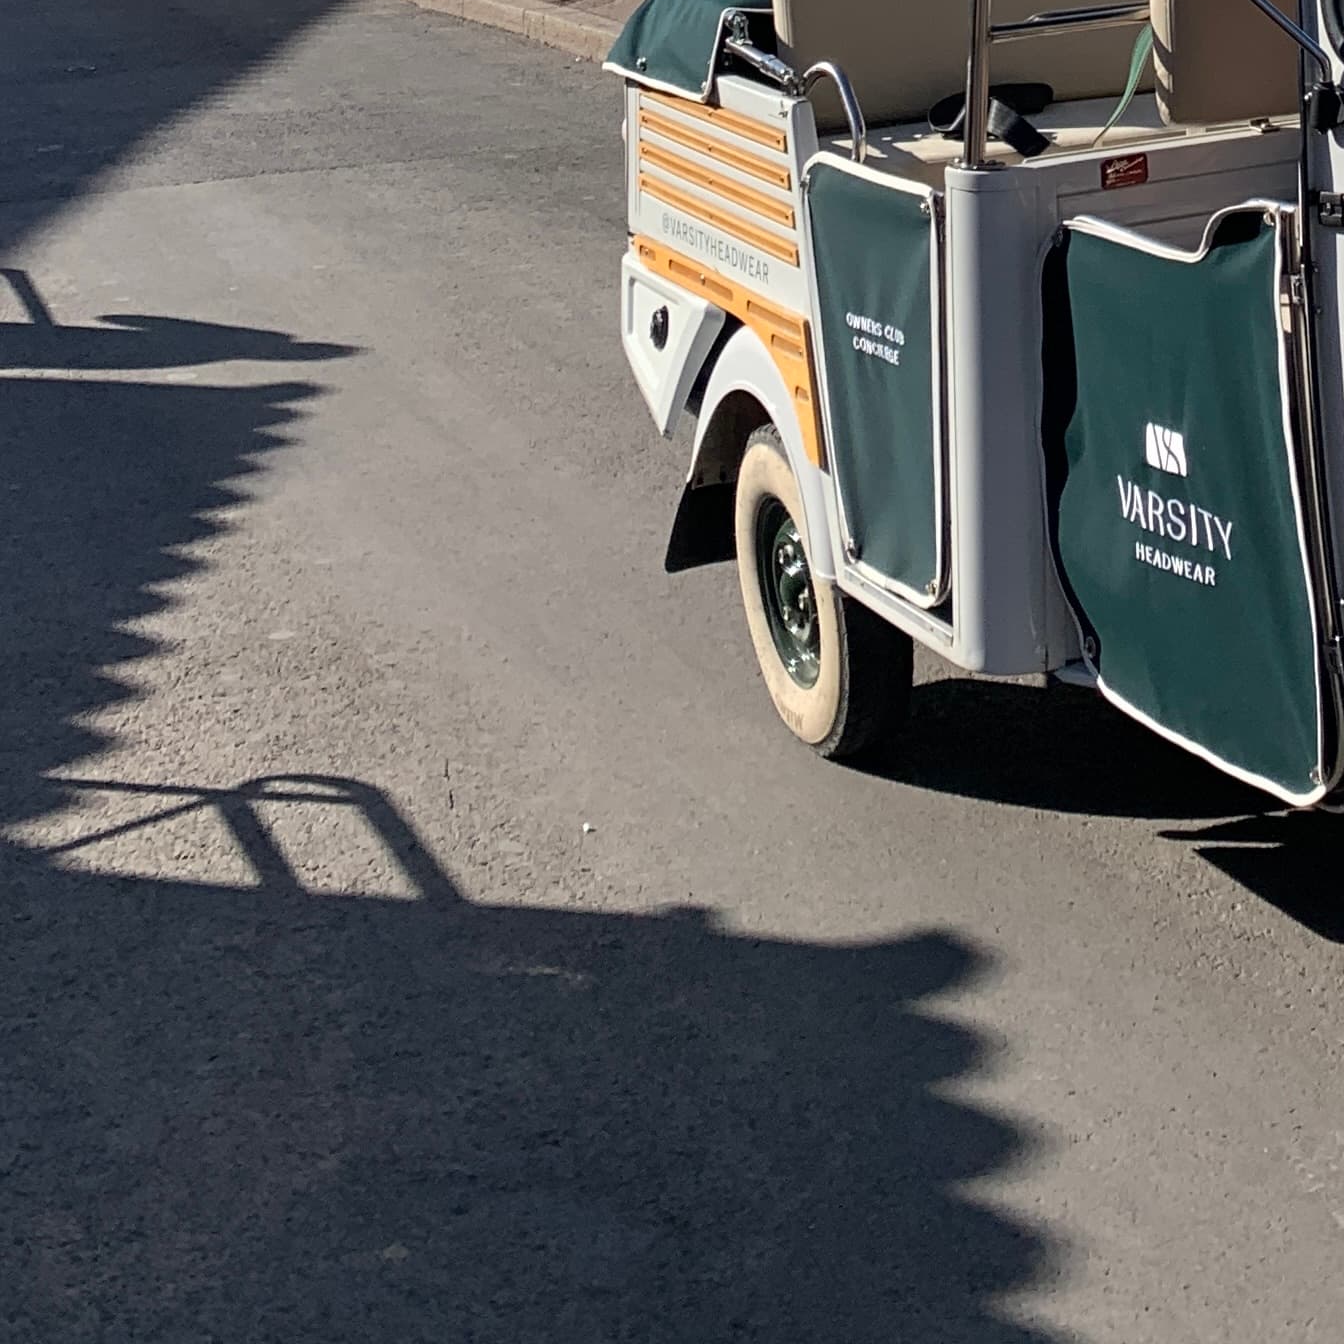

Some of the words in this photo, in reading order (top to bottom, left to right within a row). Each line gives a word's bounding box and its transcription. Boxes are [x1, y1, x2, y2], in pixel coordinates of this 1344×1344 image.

[661, 212, 770, 284] @VARSITYHEADWEAR
[846, 311, 883, 338] OWNERS
[884, 324, 905, 346] CLUB
[1117, 474, 1232, 561] VARSITY
[1135, 541, 1216, 586] HEADWEAR
